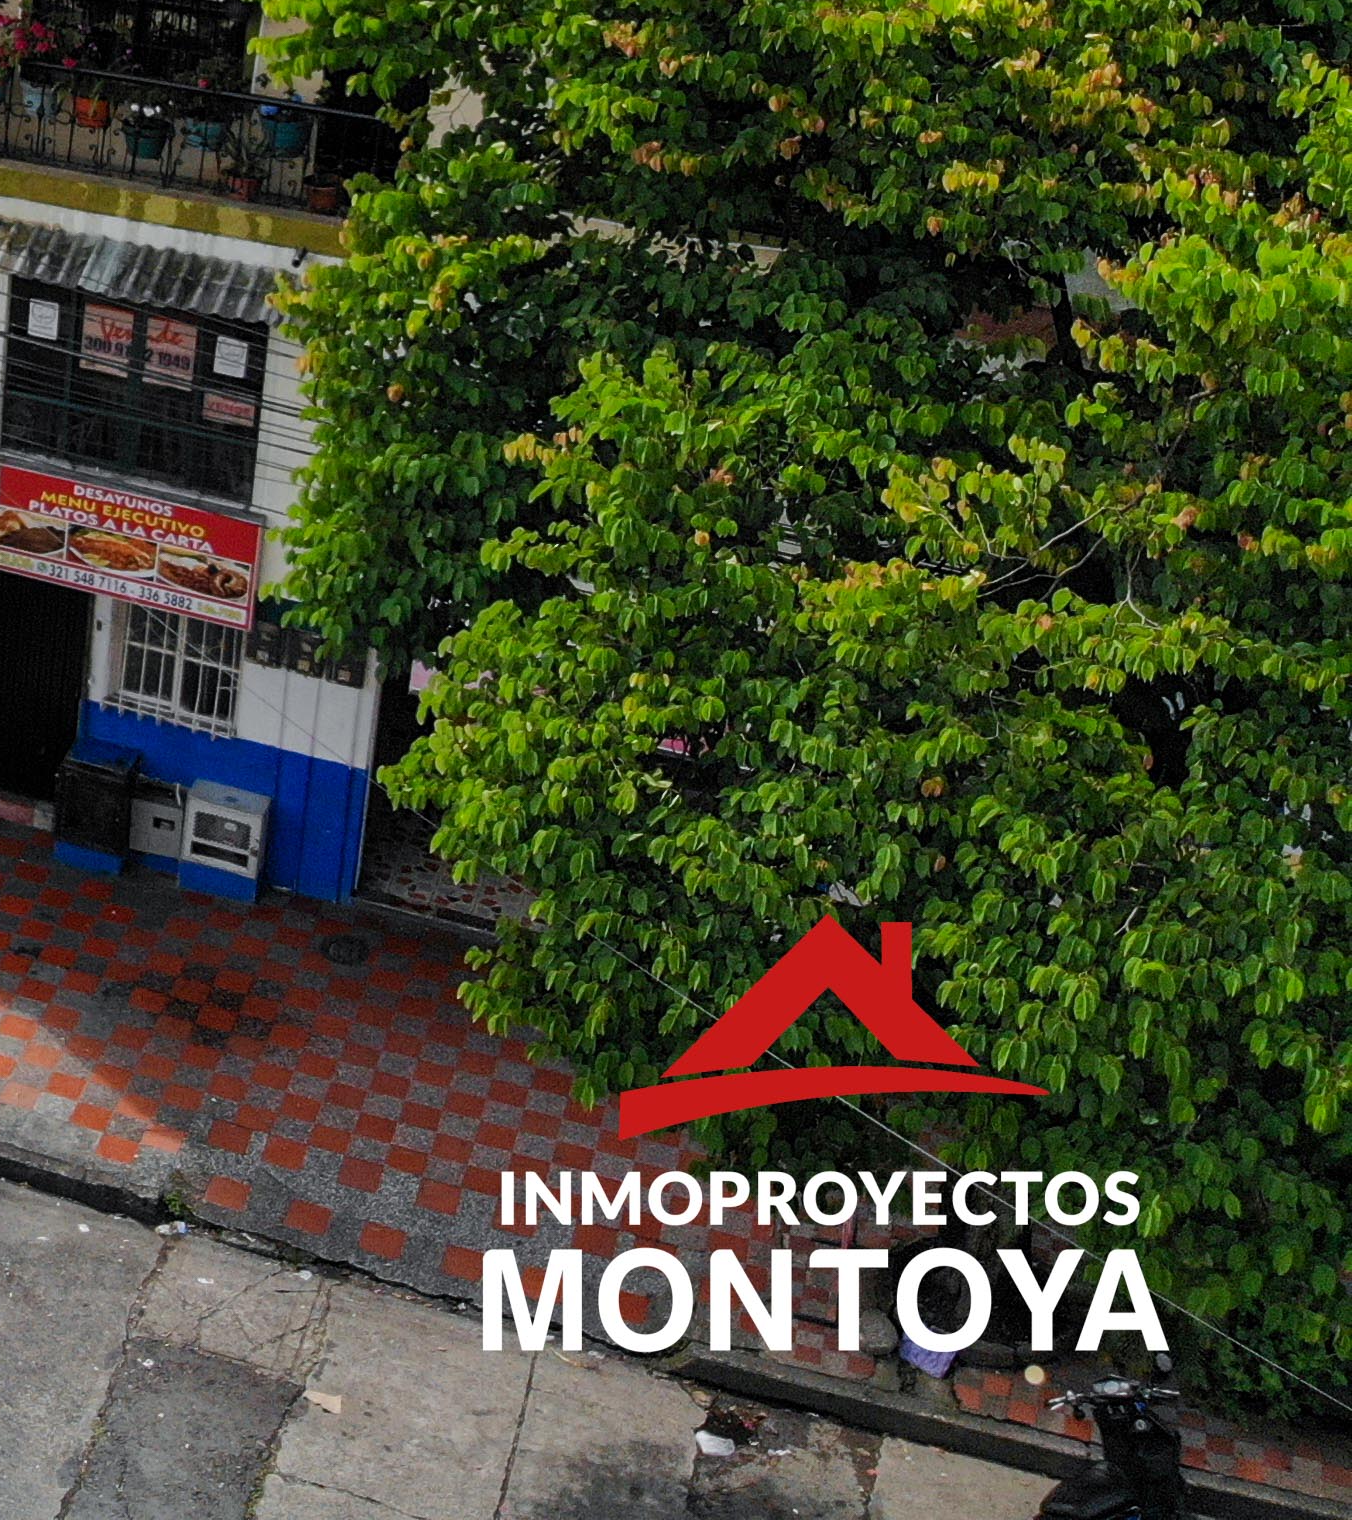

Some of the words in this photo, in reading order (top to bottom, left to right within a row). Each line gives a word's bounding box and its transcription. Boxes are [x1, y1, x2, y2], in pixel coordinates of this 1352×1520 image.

[40, 491, 96, 512] MENU
[102, 505, 205, 538] EJECUTIVO
[73, 484, 173, 517] DESAYUNOS
[28, 499, 98, 526] PLATOS
[102, 518, 117, 530] A
[122, 521, 146, 537] LA
[151, 529, 214, 554] CARTA
[49, 564, 69, 579] 321
[73, 571, 95, 586] 548
[99, 576, 127, 593] 7116
[139, 586, 161, 602] 336
[164, 593, 192, 610] 5882
